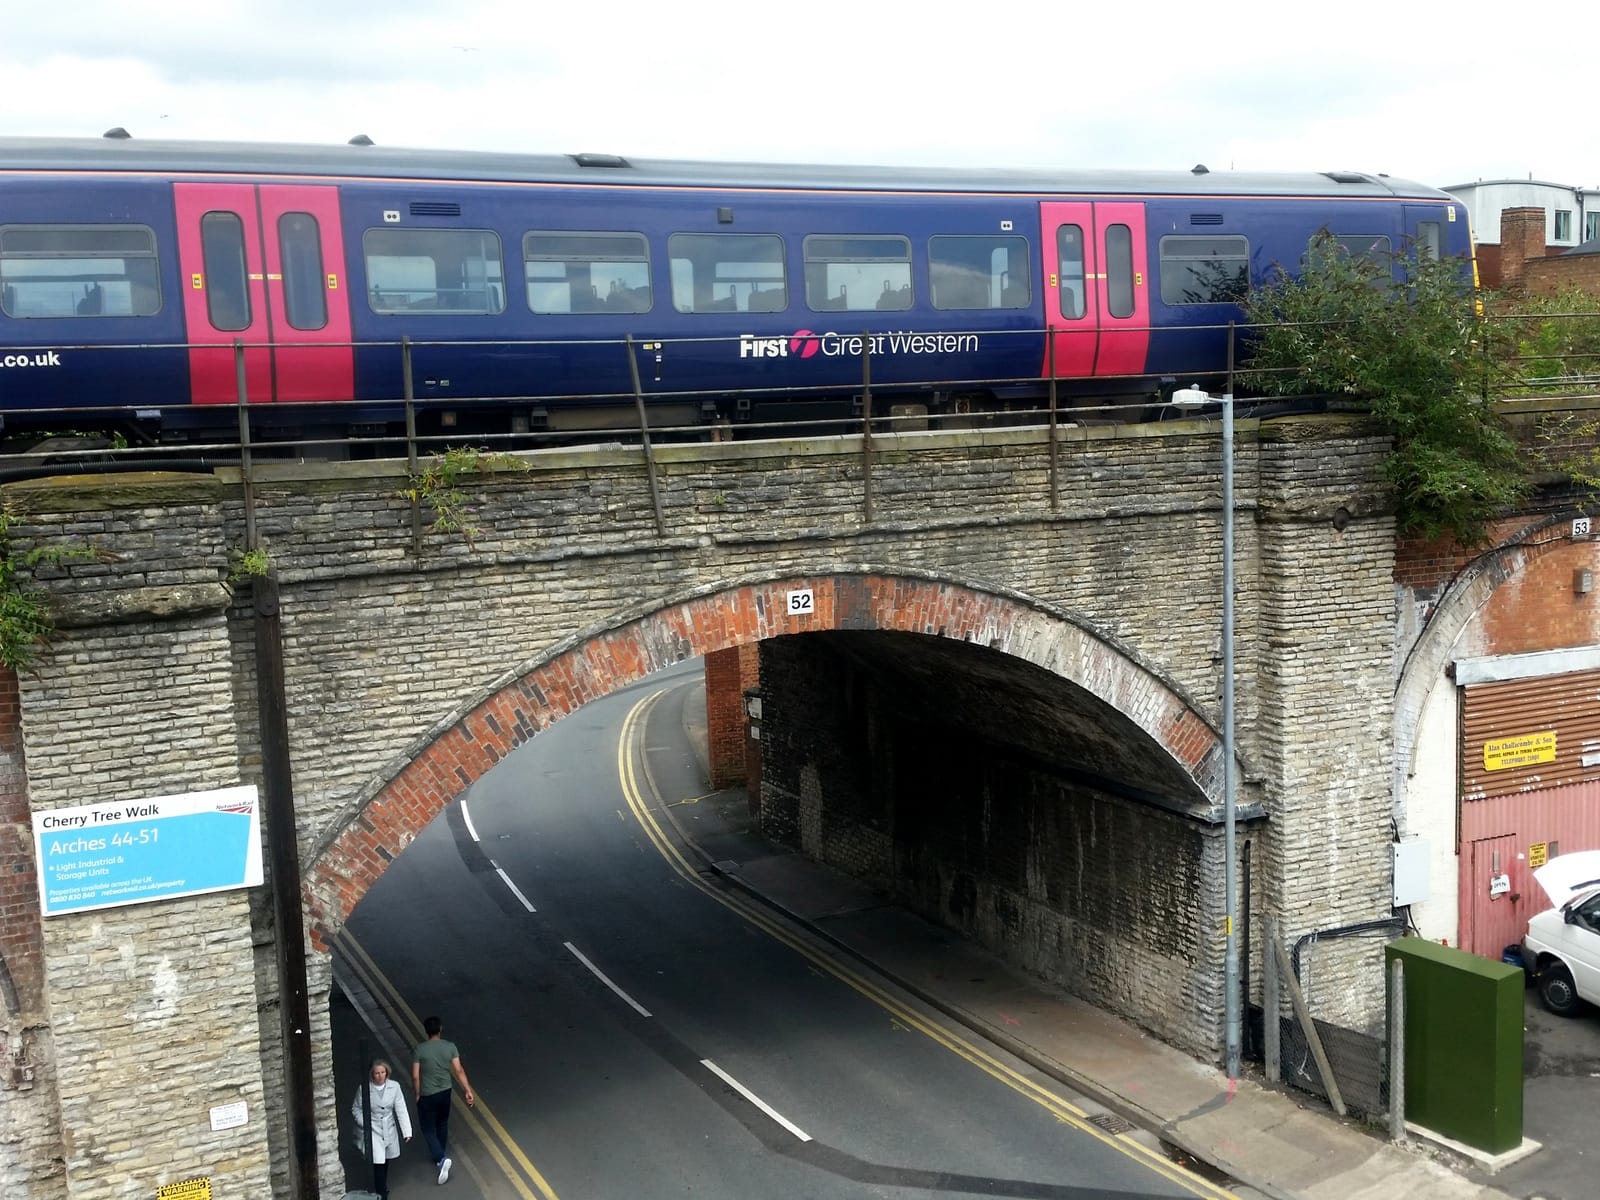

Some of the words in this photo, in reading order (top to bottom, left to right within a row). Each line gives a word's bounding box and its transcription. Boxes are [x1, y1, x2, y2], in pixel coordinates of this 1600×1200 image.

[740, 334, 788, 358] First
[821, 331, 885, 356] Great
[888, 330, 979, 354] Western
[0, 350, 61, 368] .co.uk
[1575, 521, 1588, 534] 53
[791, 594, 811, 609] 52
[1488, 744, 1500, 752] Alan
[43, 815, 88, 829] Cherry
[92, 810, 122, 823] Tree
[125, 804, 160, 818] Walk
[50, 838, 106, 856] Arches
[111, 828, 158, 846] 44-51
[56, 862, 76, 873] Light
[79, 856, 115, 868] Industrial
[116, 856, 124, 864] &
[56, 871, 86, 881] Storage
[88, 867, 109, 877] Units
[82, 881, 109, 892] available
[163, 1181, 205, 1197] WARNING
